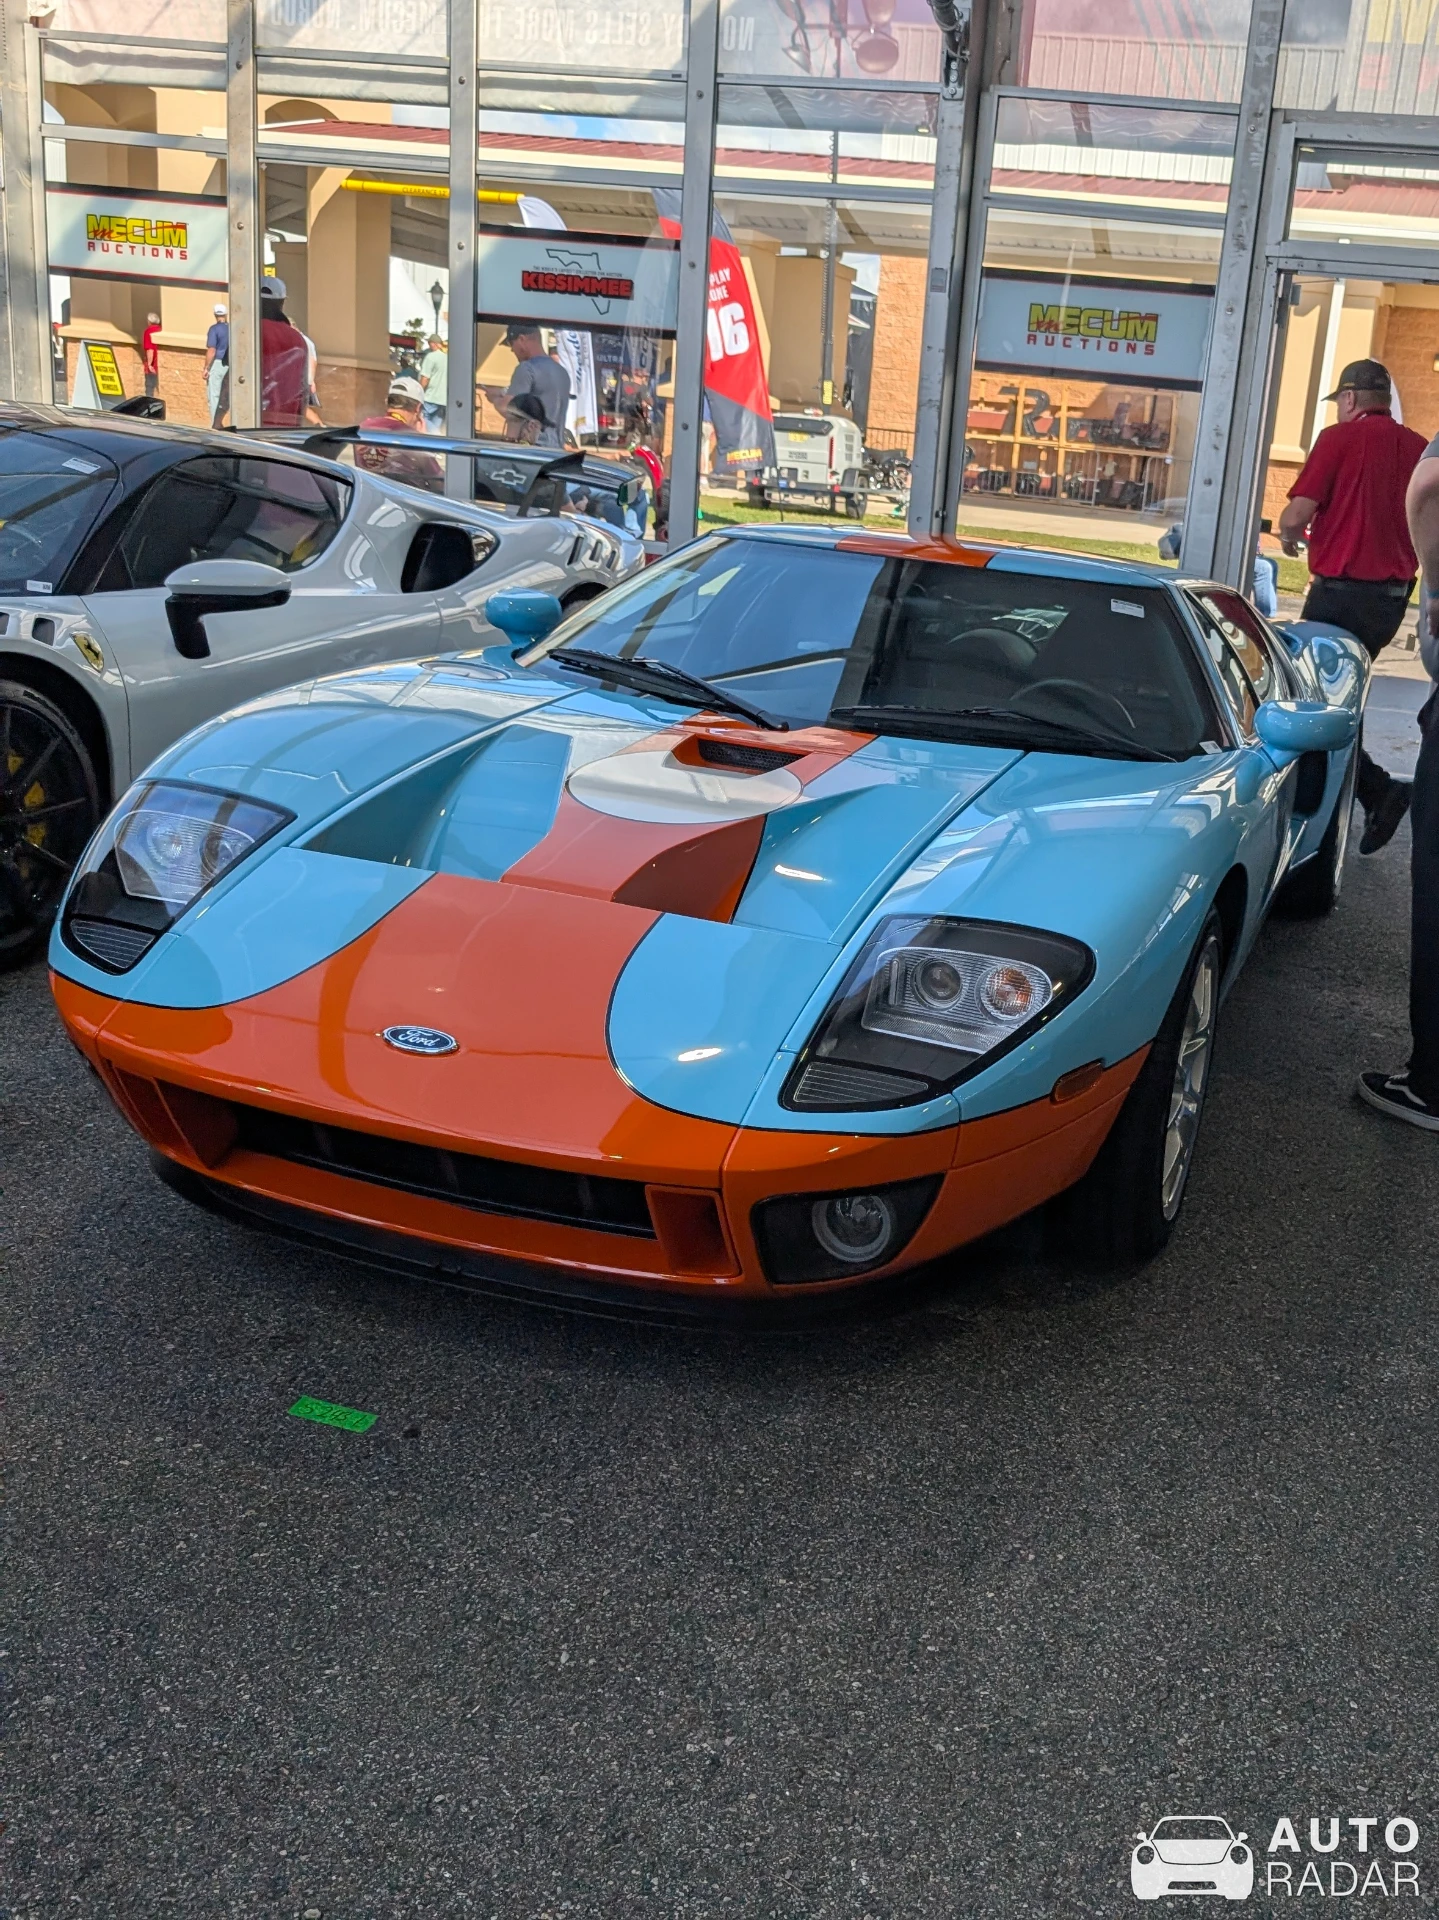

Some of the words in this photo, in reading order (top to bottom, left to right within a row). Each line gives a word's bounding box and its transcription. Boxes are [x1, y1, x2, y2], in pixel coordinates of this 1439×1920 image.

[86, 214, 187, 248] MECUM
[87, 241, 188, 260] AUCTIONS
[522, 271, 634, 300] KISSIMMEE
[709, 267, 731, 287] PLAY
[709, 285, 729, 302] ONE
[1028, 303, 1158, 343] MECUM
[1027, 333, 1155, 356] AUCTIONS
[398, 1029, 440, 1047] Ford
